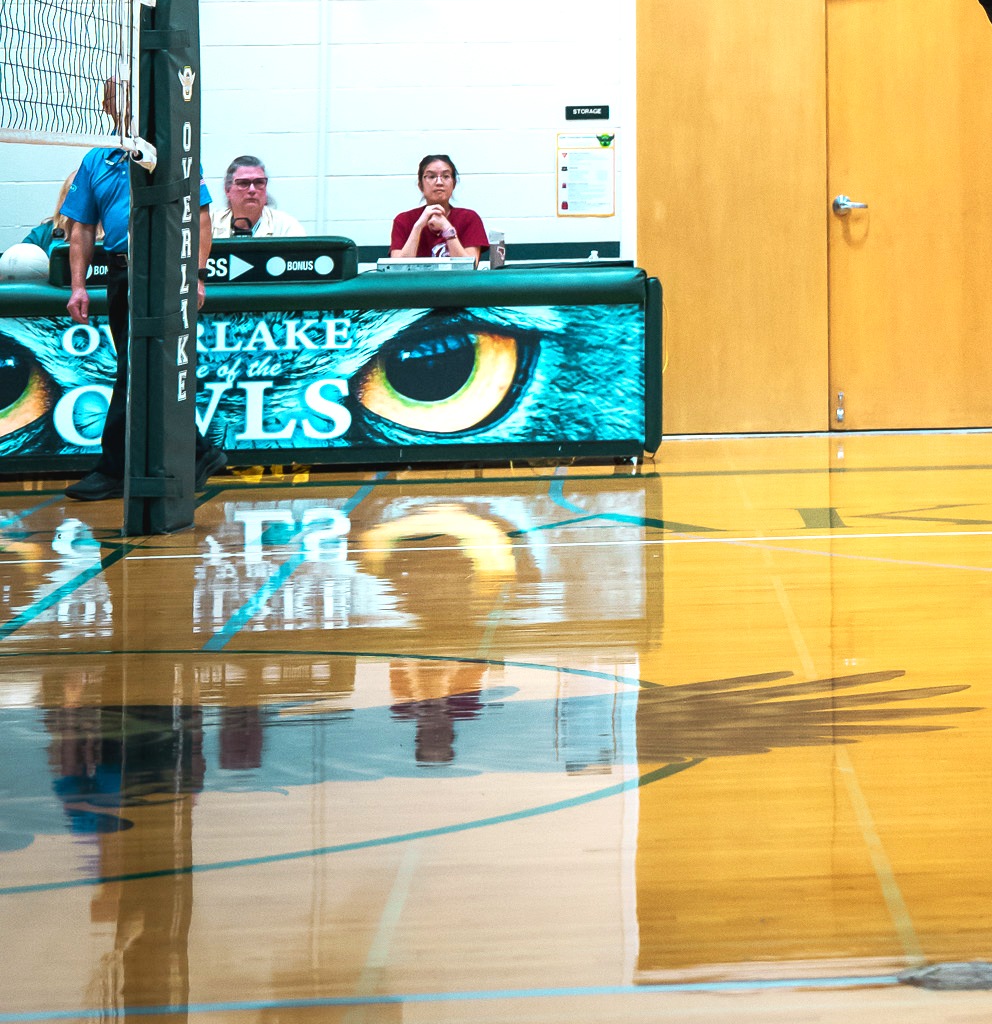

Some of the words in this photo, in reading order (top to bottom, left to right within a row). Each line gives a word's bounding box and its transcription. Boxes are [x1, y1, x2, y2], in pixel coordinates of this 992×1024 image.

[93, 265, 109, 276] BON
[287, 261, 314, 271] BONUS
[217, 358, 242, 385] of
[246, 356, 283, 377] the
